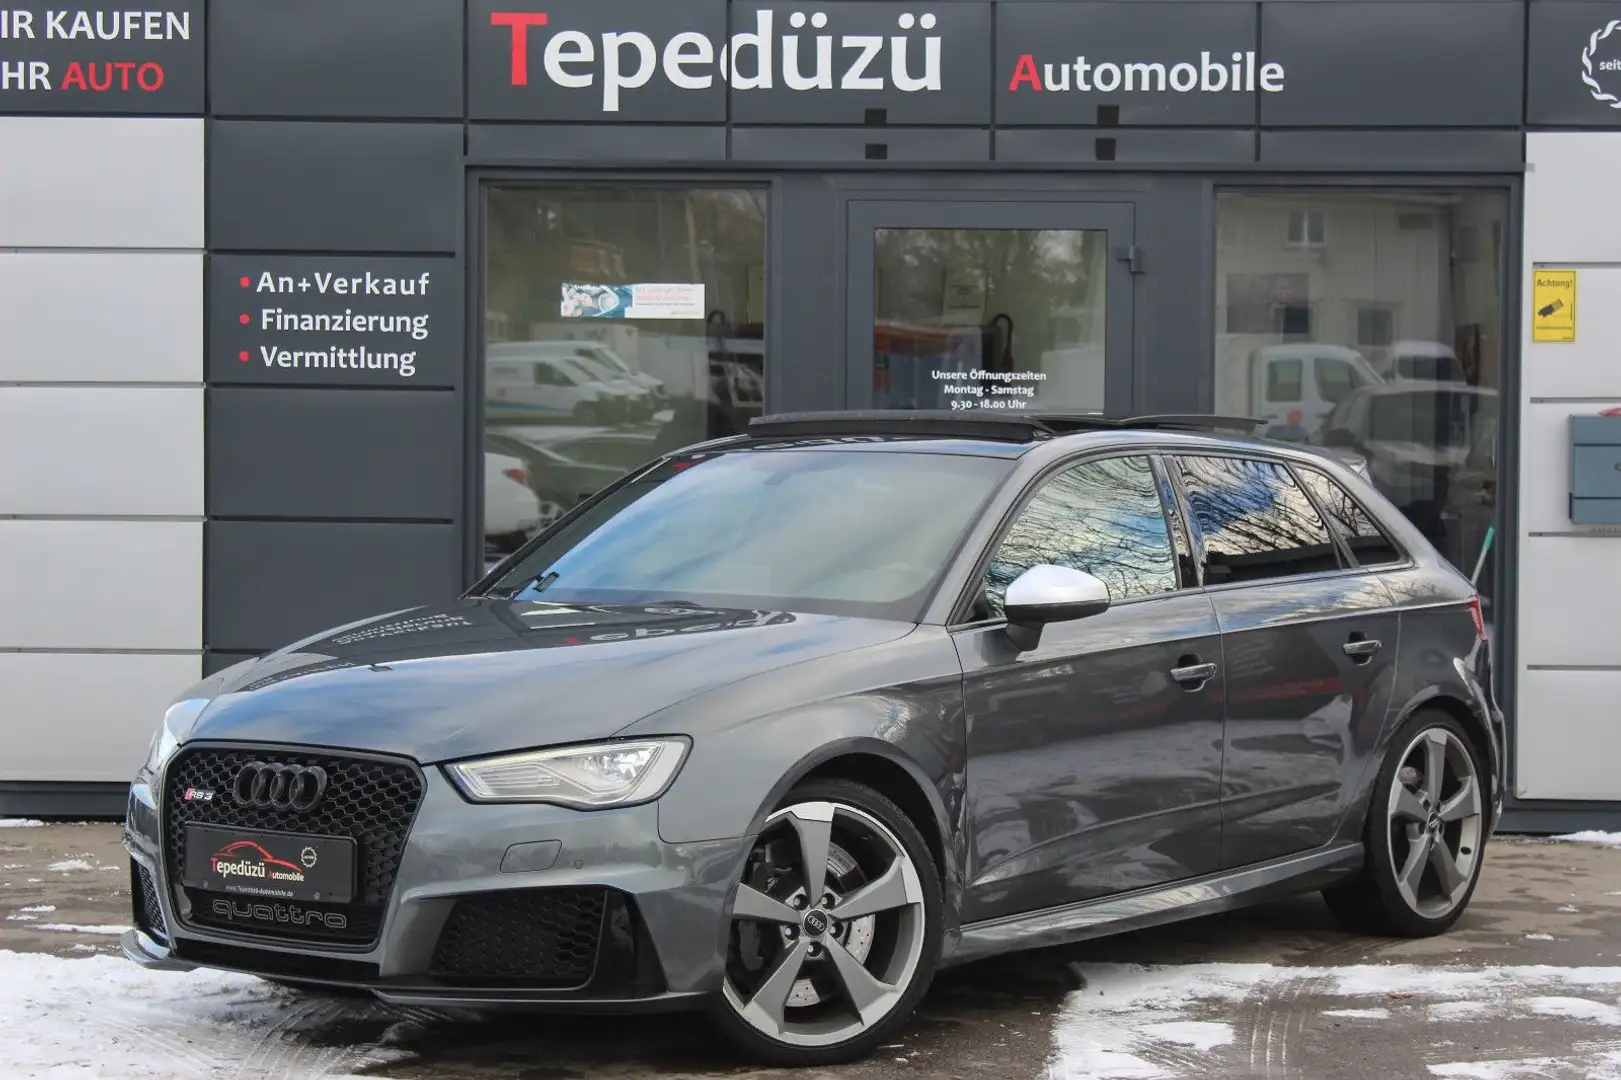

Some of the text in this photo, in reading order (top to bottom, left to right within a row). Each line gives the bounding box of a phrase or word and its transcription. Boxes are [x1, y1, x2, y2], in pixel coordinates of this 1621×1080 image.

[46, 11, 190, 40] KAUFEN
[491, 10, 1285, 111] Tepedüzü Automobile
[60, 61, 165, 91] AUTO
[256, 271, 430, 296] An+Verkauf
[1536, 278, 1573, 289] Achtung!
[260, 307, 429, 340] Finanzierung
[260, 345, 416, 377] Vermittlung
[931, 369, 1046, 382] Unsere Öffnungszeiten
[944, 385, 984, 397] Montag
[991, 385, 1034, 397] Samstag
[951, 401, 972, 410] 9.30
[980, 399, 1006, 409] 18.00
[1007, 399, 1027, 409] Uhr
[211, 857, 305, 882] Tepedüzü Automobile
[213, 899, 346, 928] quattro
